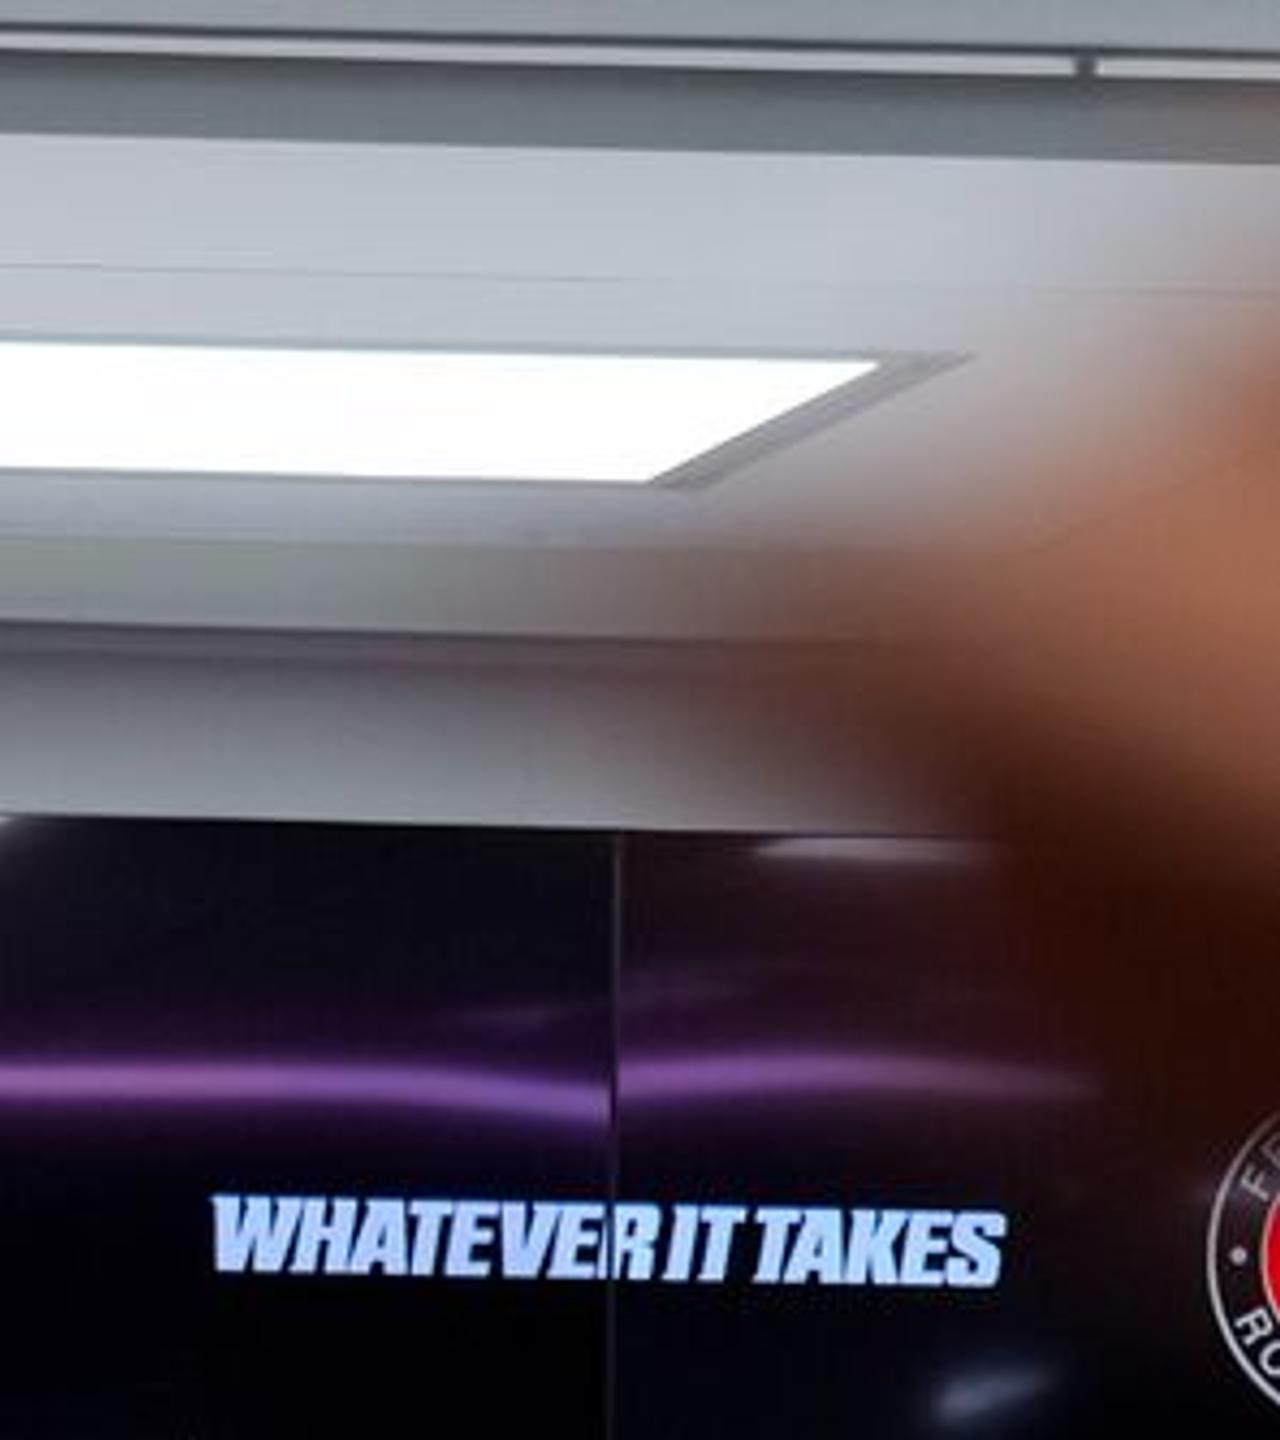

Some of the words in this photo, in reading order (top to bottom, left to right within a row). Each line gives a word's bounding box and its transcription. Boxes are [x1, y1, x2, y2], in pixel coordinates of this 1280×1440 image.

[211, 1195, 658, 1279] WHATEVER
[661, 1205, 744, 1282] IT
[753, 1207, 1006, 1287] TAKES
